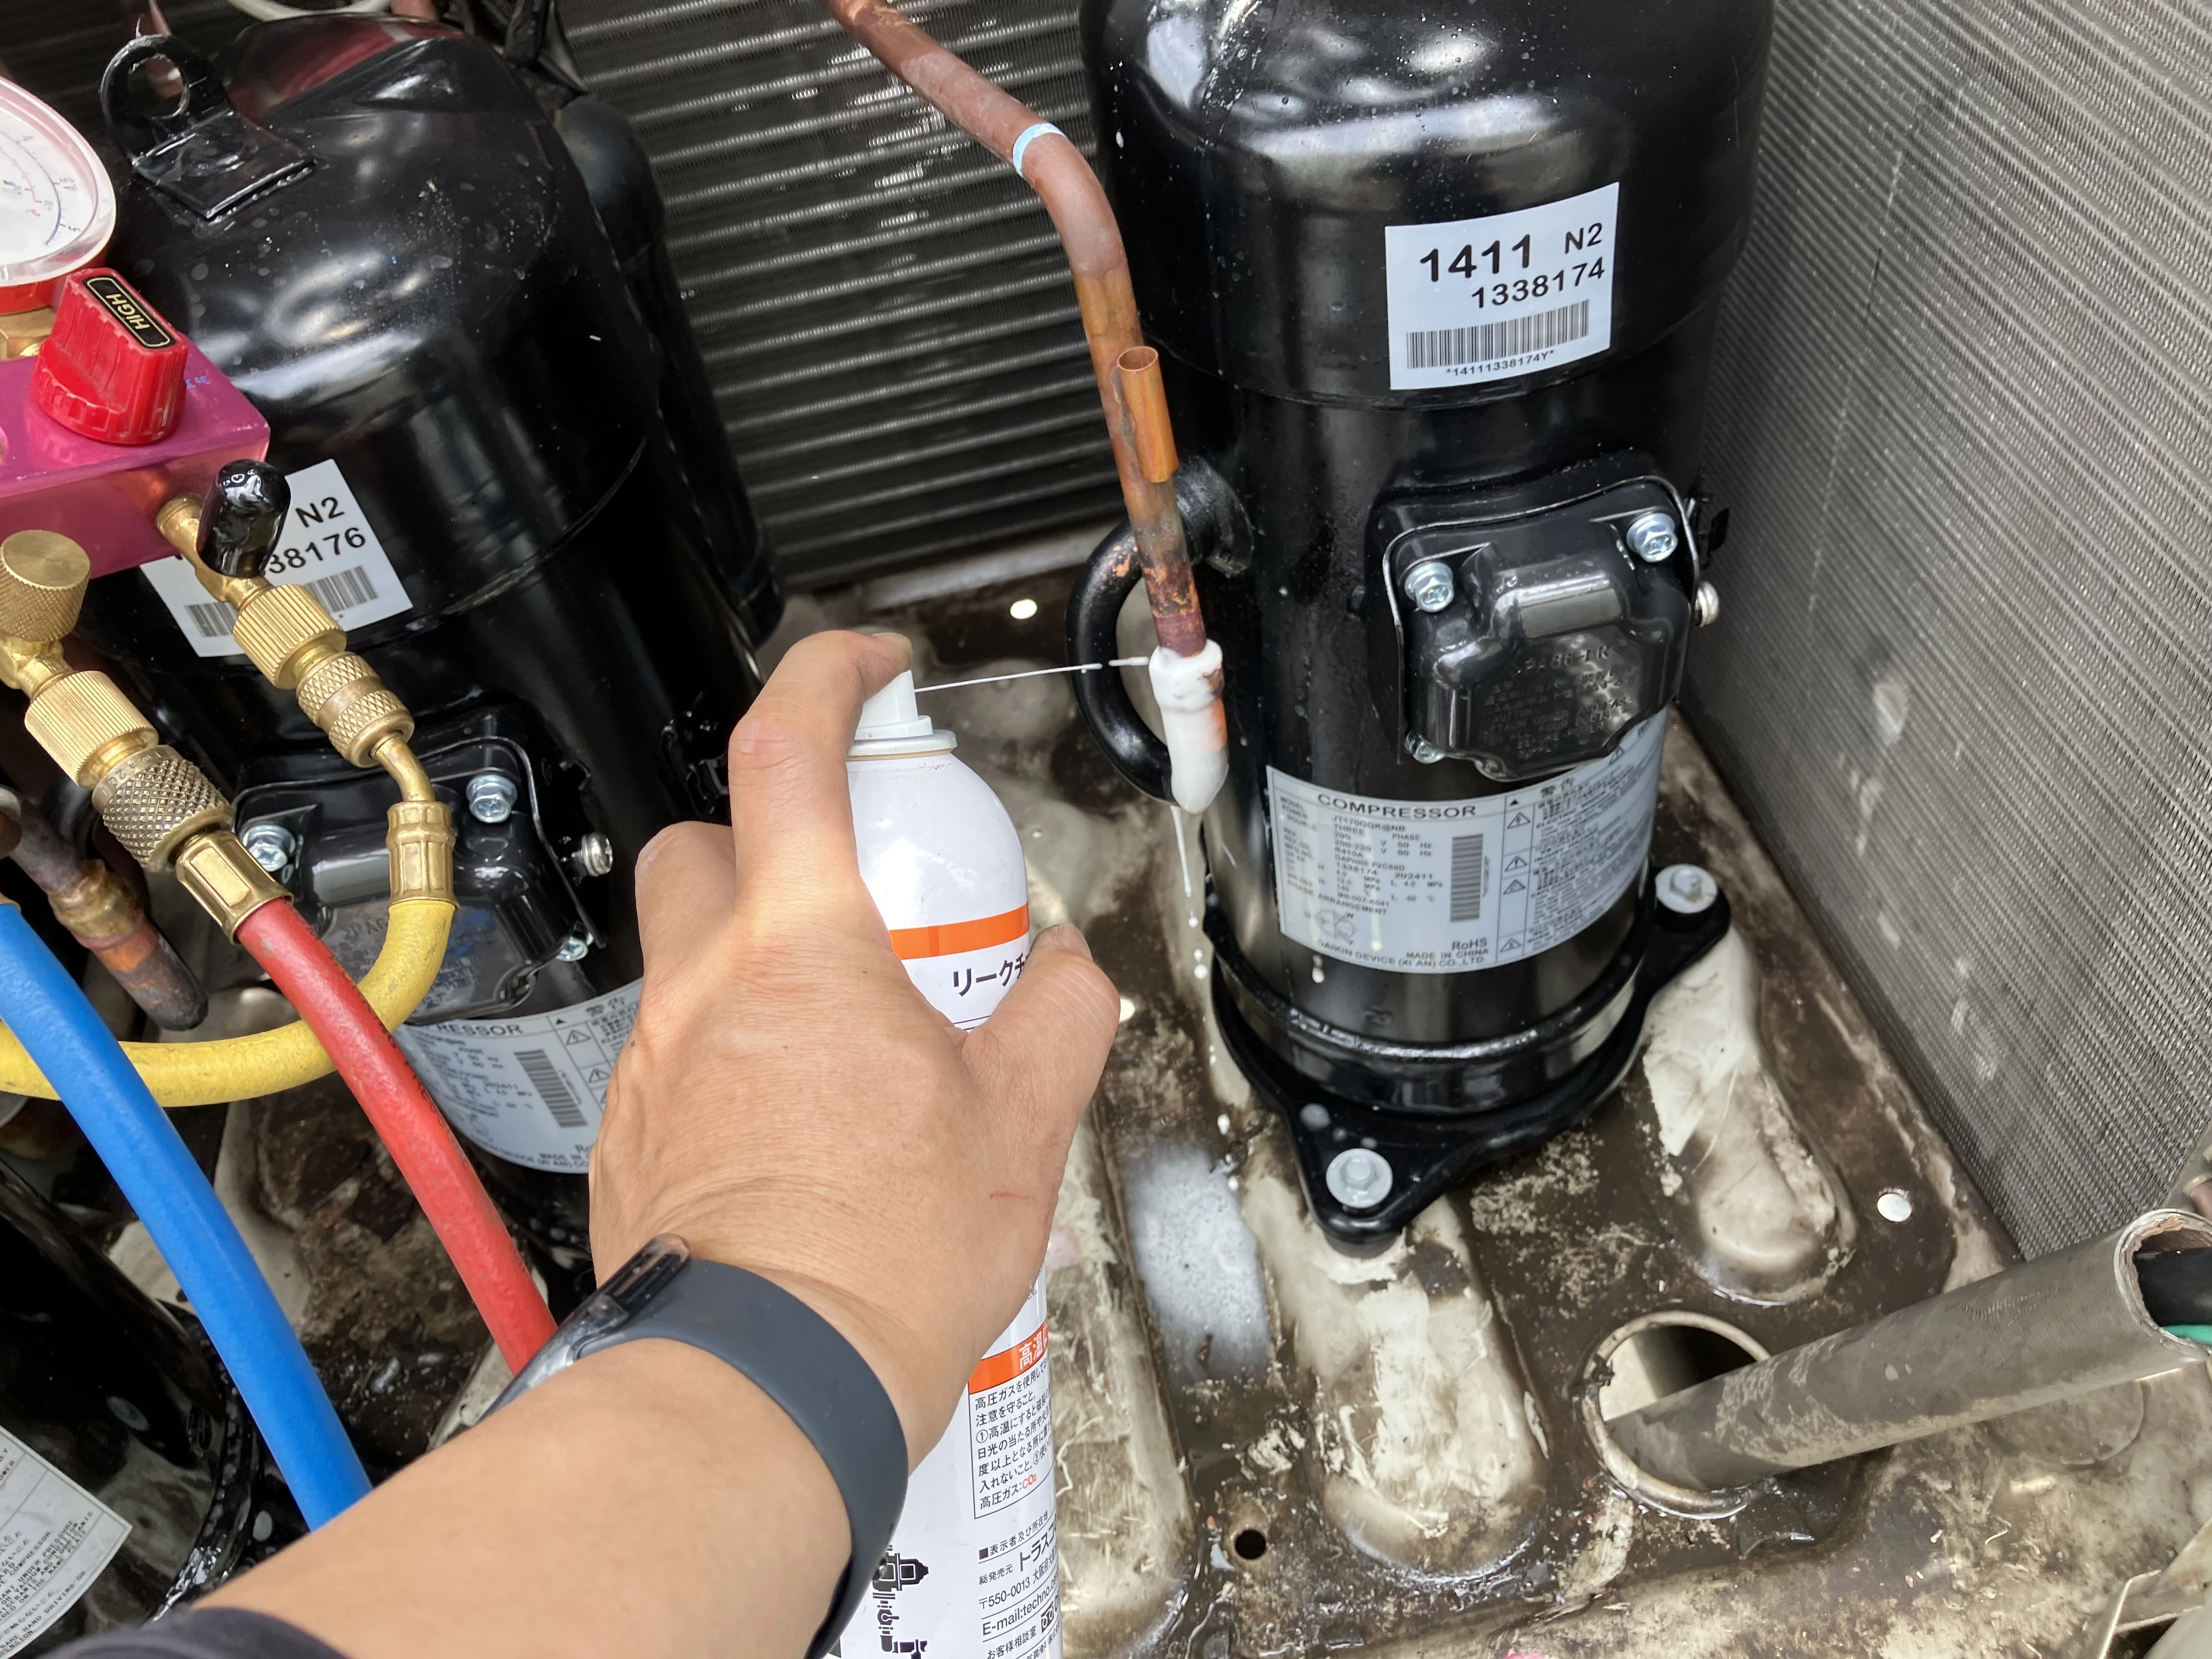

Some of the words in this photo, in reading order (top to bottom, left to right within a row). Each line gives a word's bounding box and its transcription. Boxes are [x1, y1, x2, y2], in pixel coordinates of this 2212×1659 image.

[1420, 234, 1531, 282] 1411
[1565, 222, 1602, 254] N2
[1471, 256, 1605, 308] 1338174
[106, 294, 150, 330] HIGH
[295, 497, 345, 528] N2
[268, 527, 366, 574] 38176
[1318, 793, 1476, 819] COMPRESSOR
[1334, 824, 1364, 836] THREE
[1395, 872, 1433, 880] 202411
[1318, 893, 1387, 915] ARRANGEMENT
[1317, 939, 1353, 957] DAIKIN
[1355, 951, 1396, 966] DEVICE
[1406, 951, 1436, 960] MADE
[1456, 947, 1489, 958] CHINA
[1452, 936, 1488, 951] RoHS
[953, 952, 1029, 997] リークチ
[437, 1023, 523, 1036] RESSOR
[975, 1355, 1049, 1411] 高圧ガスを使用してお
[975, 1390, 1036, 1427] 注意を守ること。
[9, 1531, 50, 1576] COMPRESSOR
[979, 1564, 1013, 1585] 総発売元
[983, 1570, 1059, 1636] E-mail:techno.co
[22, 1615, 42, 1632] HAND
